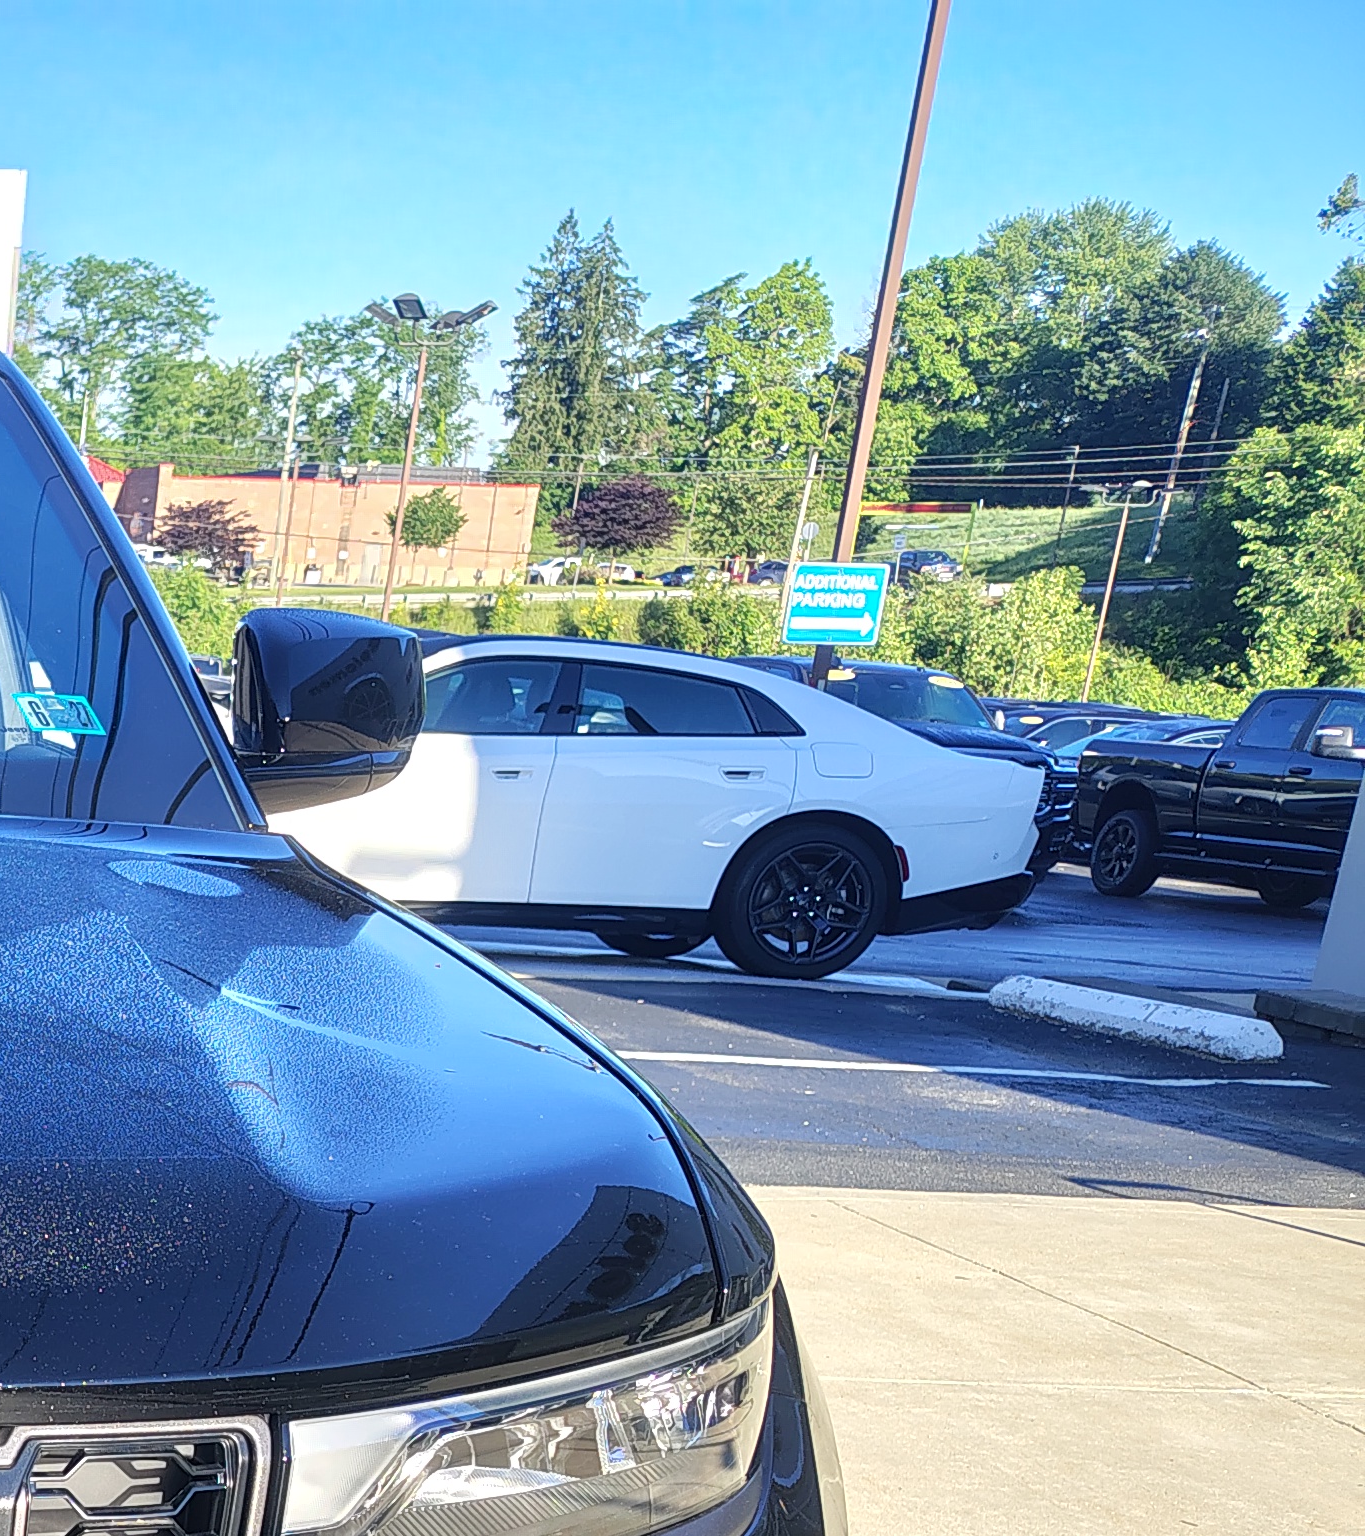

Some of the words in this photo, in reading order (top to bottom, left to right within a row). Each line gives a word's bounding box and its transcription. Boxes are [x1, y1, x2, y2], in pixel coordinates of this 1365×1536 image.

[794, 573, 879, 590] ADDITIONAL
[792, 592, 866, 608] PARKING
[27, 700, 51, 727] 6
